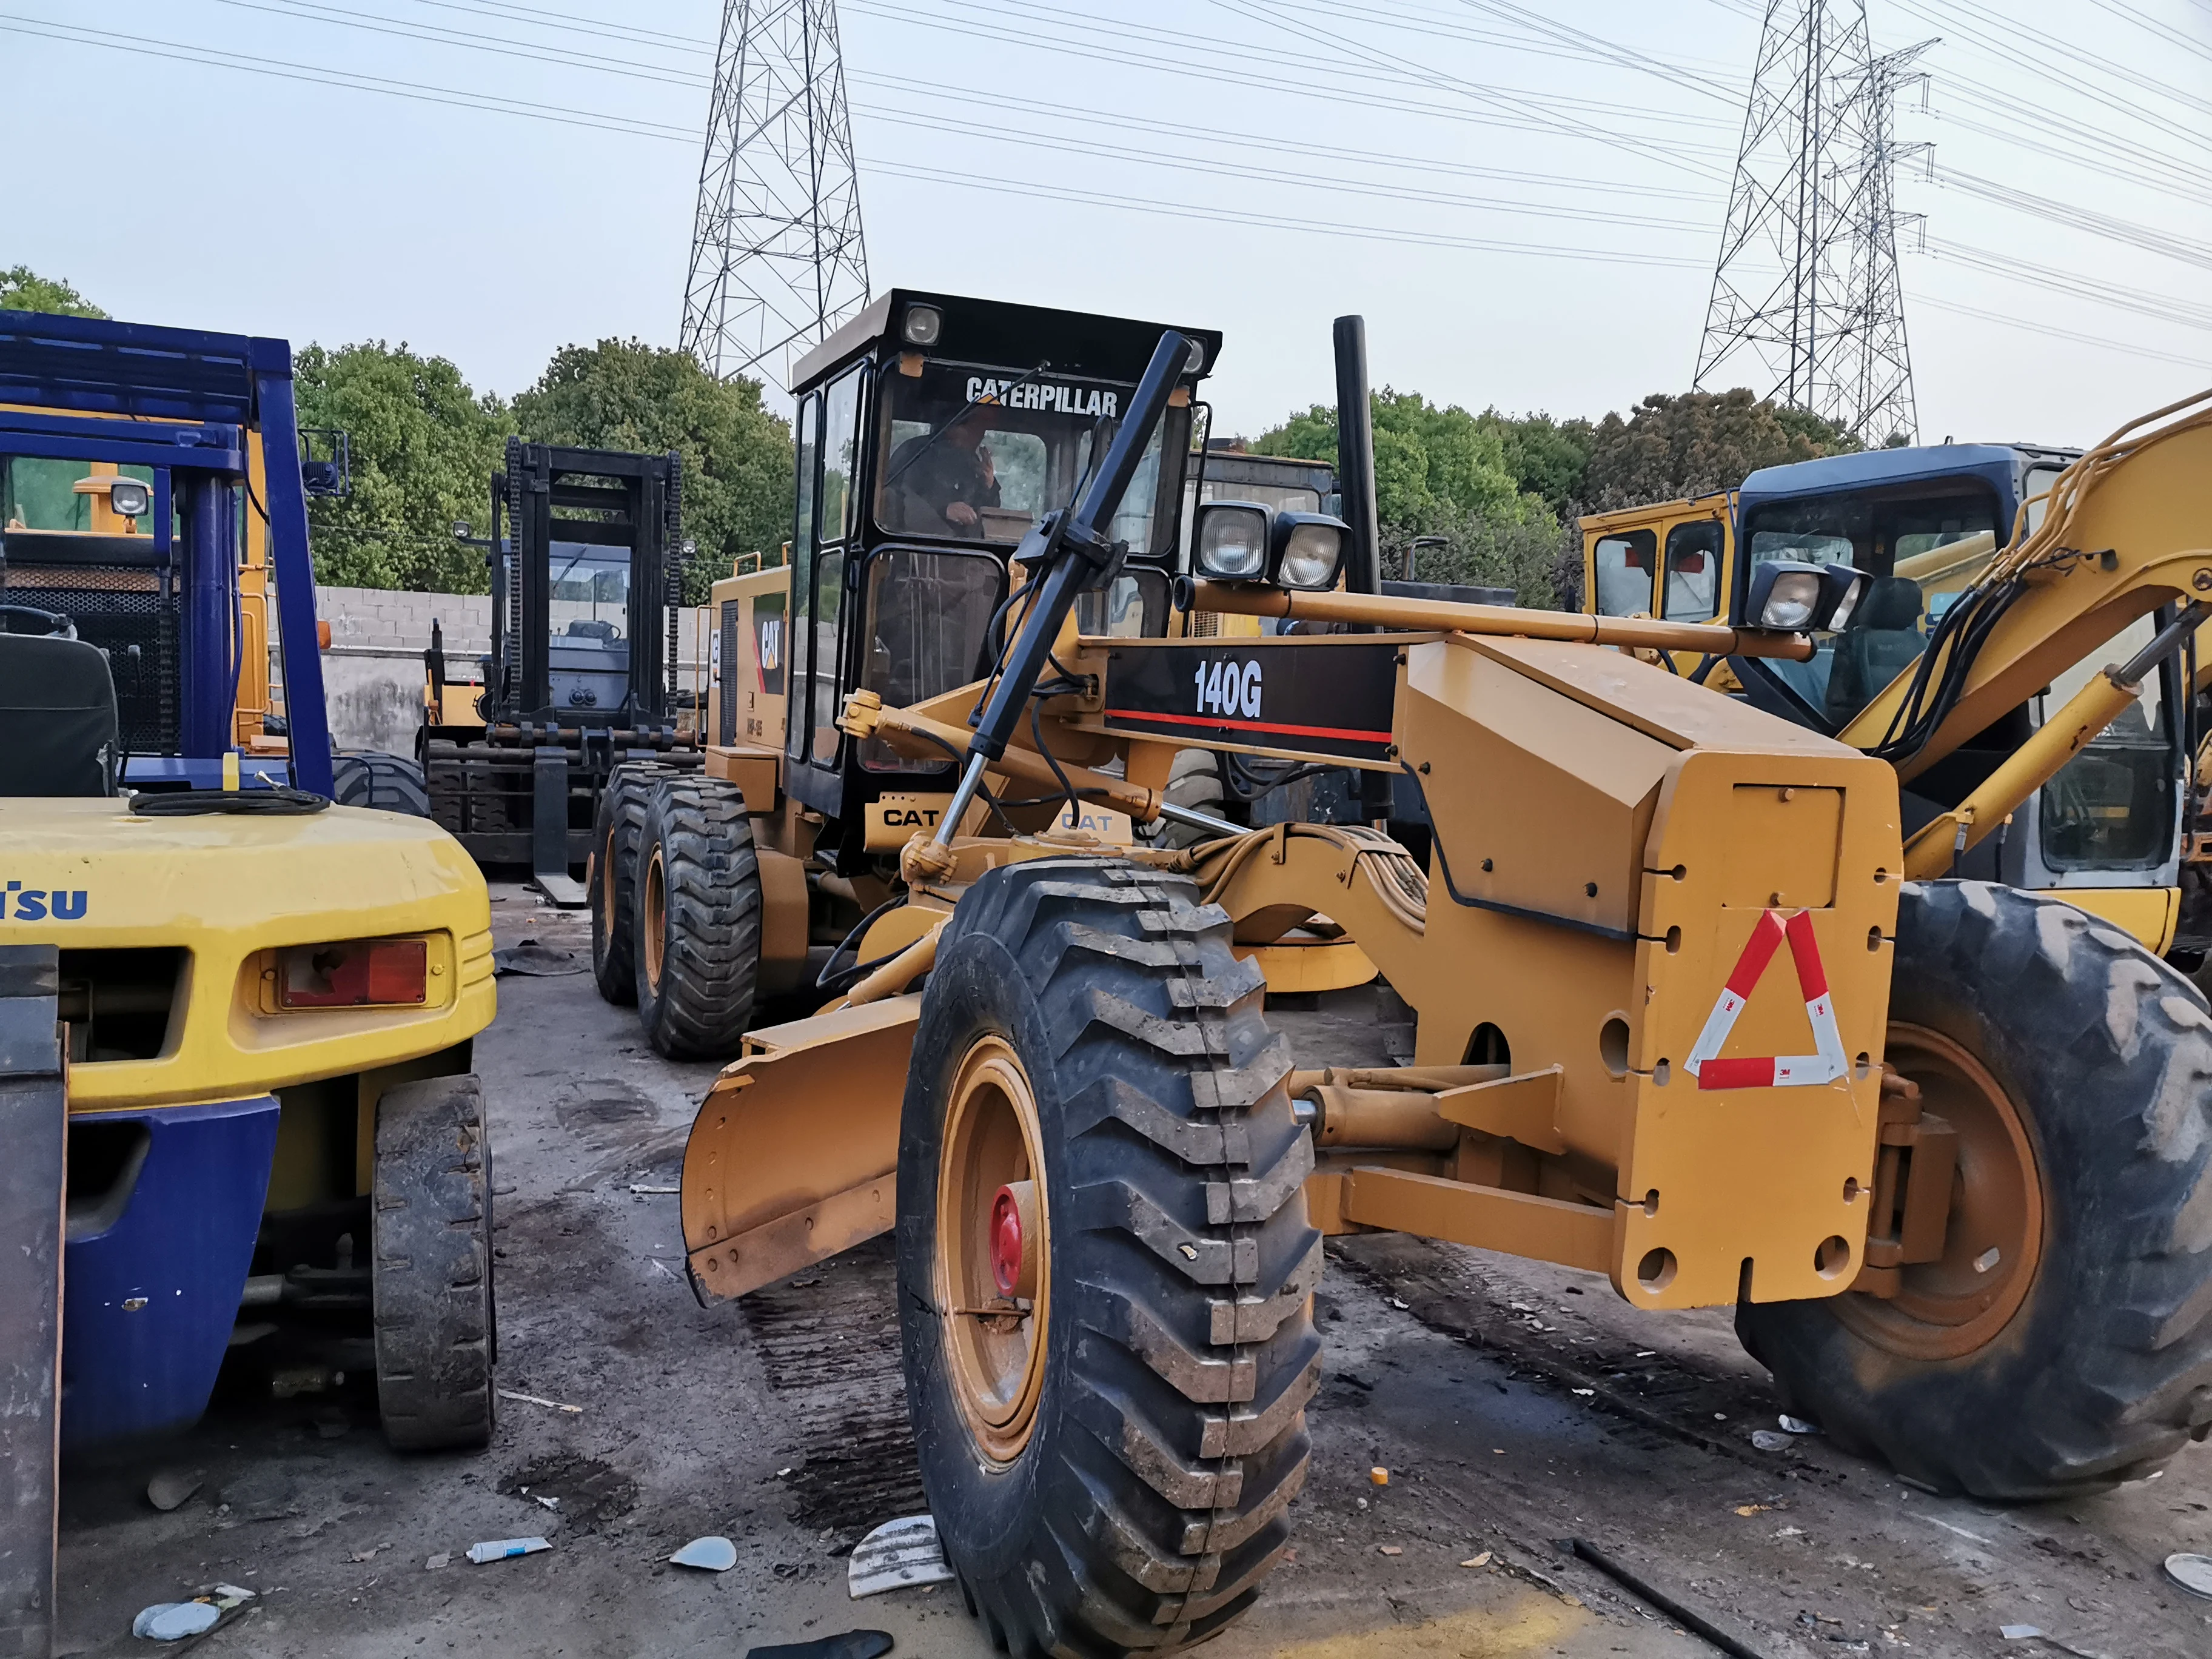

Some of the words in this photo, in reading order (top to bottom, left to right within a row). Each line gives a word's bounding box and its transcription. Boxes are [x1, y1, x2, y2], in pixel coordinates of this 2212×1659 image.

[967, 377, 1118, 417] CATERPILLAR
[762, 620, 780, 669] CAT
[1195, 660, 1262, 718] 140G
[883, 809, 939, 826] CAT
[1062, 813, 1113, 831] CAT
